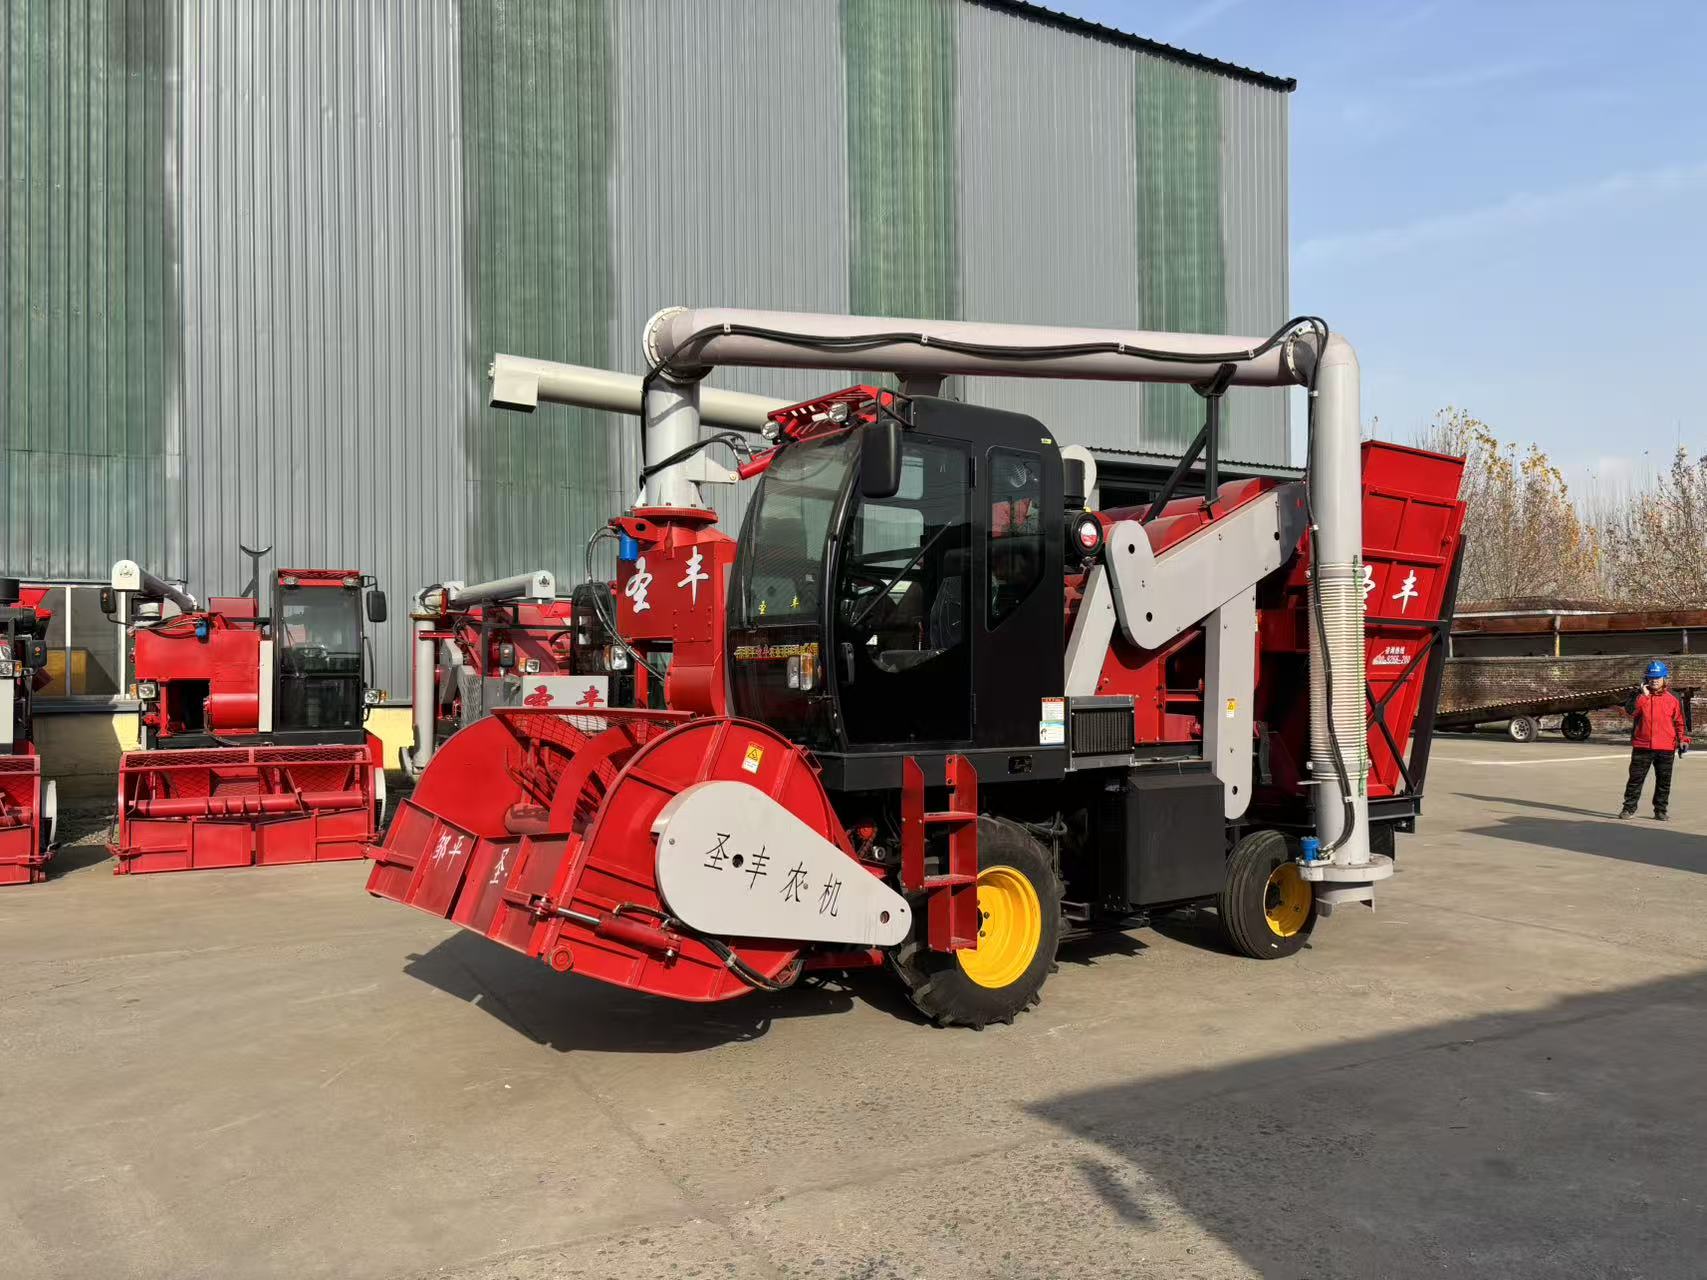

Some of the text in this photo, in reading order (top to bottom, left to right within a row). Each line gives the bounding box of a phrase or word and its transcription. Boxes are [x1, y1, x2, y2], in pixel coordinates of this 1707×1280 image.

[625, 545, 709, 613] 圣丰
[704, 832, 843, 917] 圣丰农机
